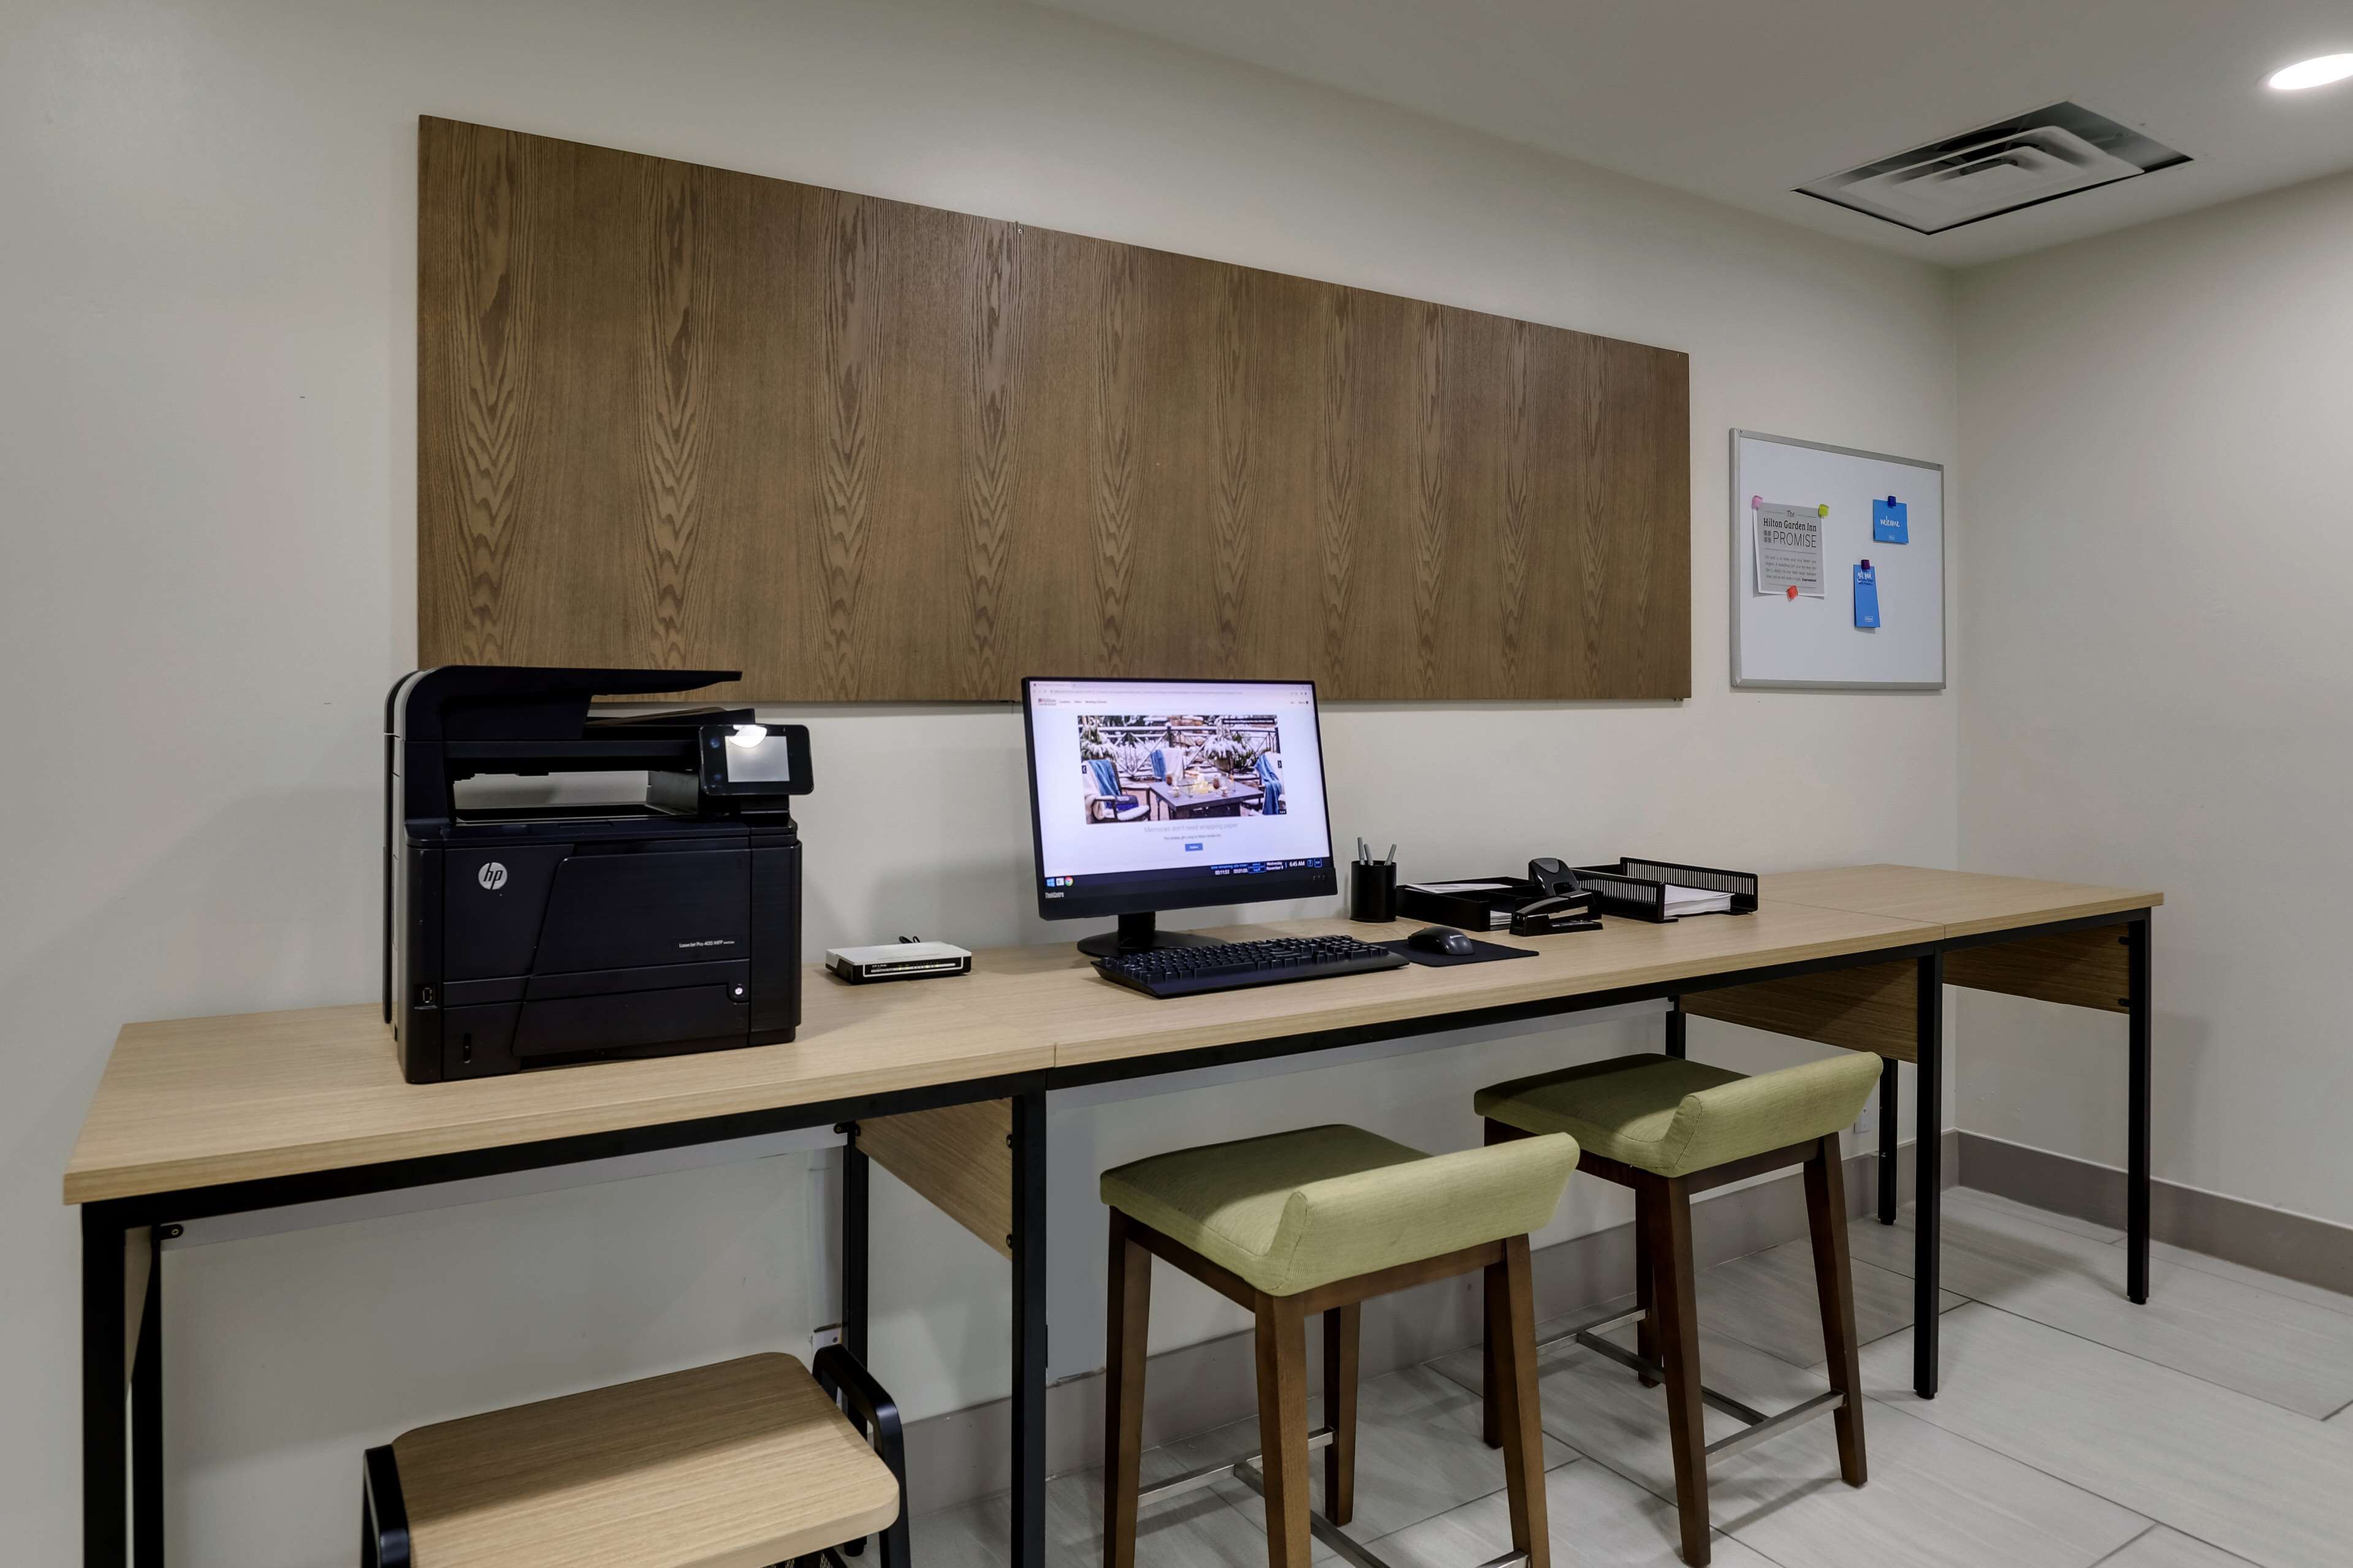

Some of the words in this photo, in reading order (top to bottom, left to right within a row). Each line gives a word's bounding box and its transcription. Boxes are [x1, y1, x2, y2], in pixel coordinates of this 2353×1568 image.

[1763, 518, 1782, 528] Hilton
[1784, 520, 1806, 531] Garden
[1807, 523, 1817, 532] Inn
[1880, 515, 1900, 528] welcome
[1773, 531, 1817, 548] PROMISE
[483, 862, 503, 890] hp
